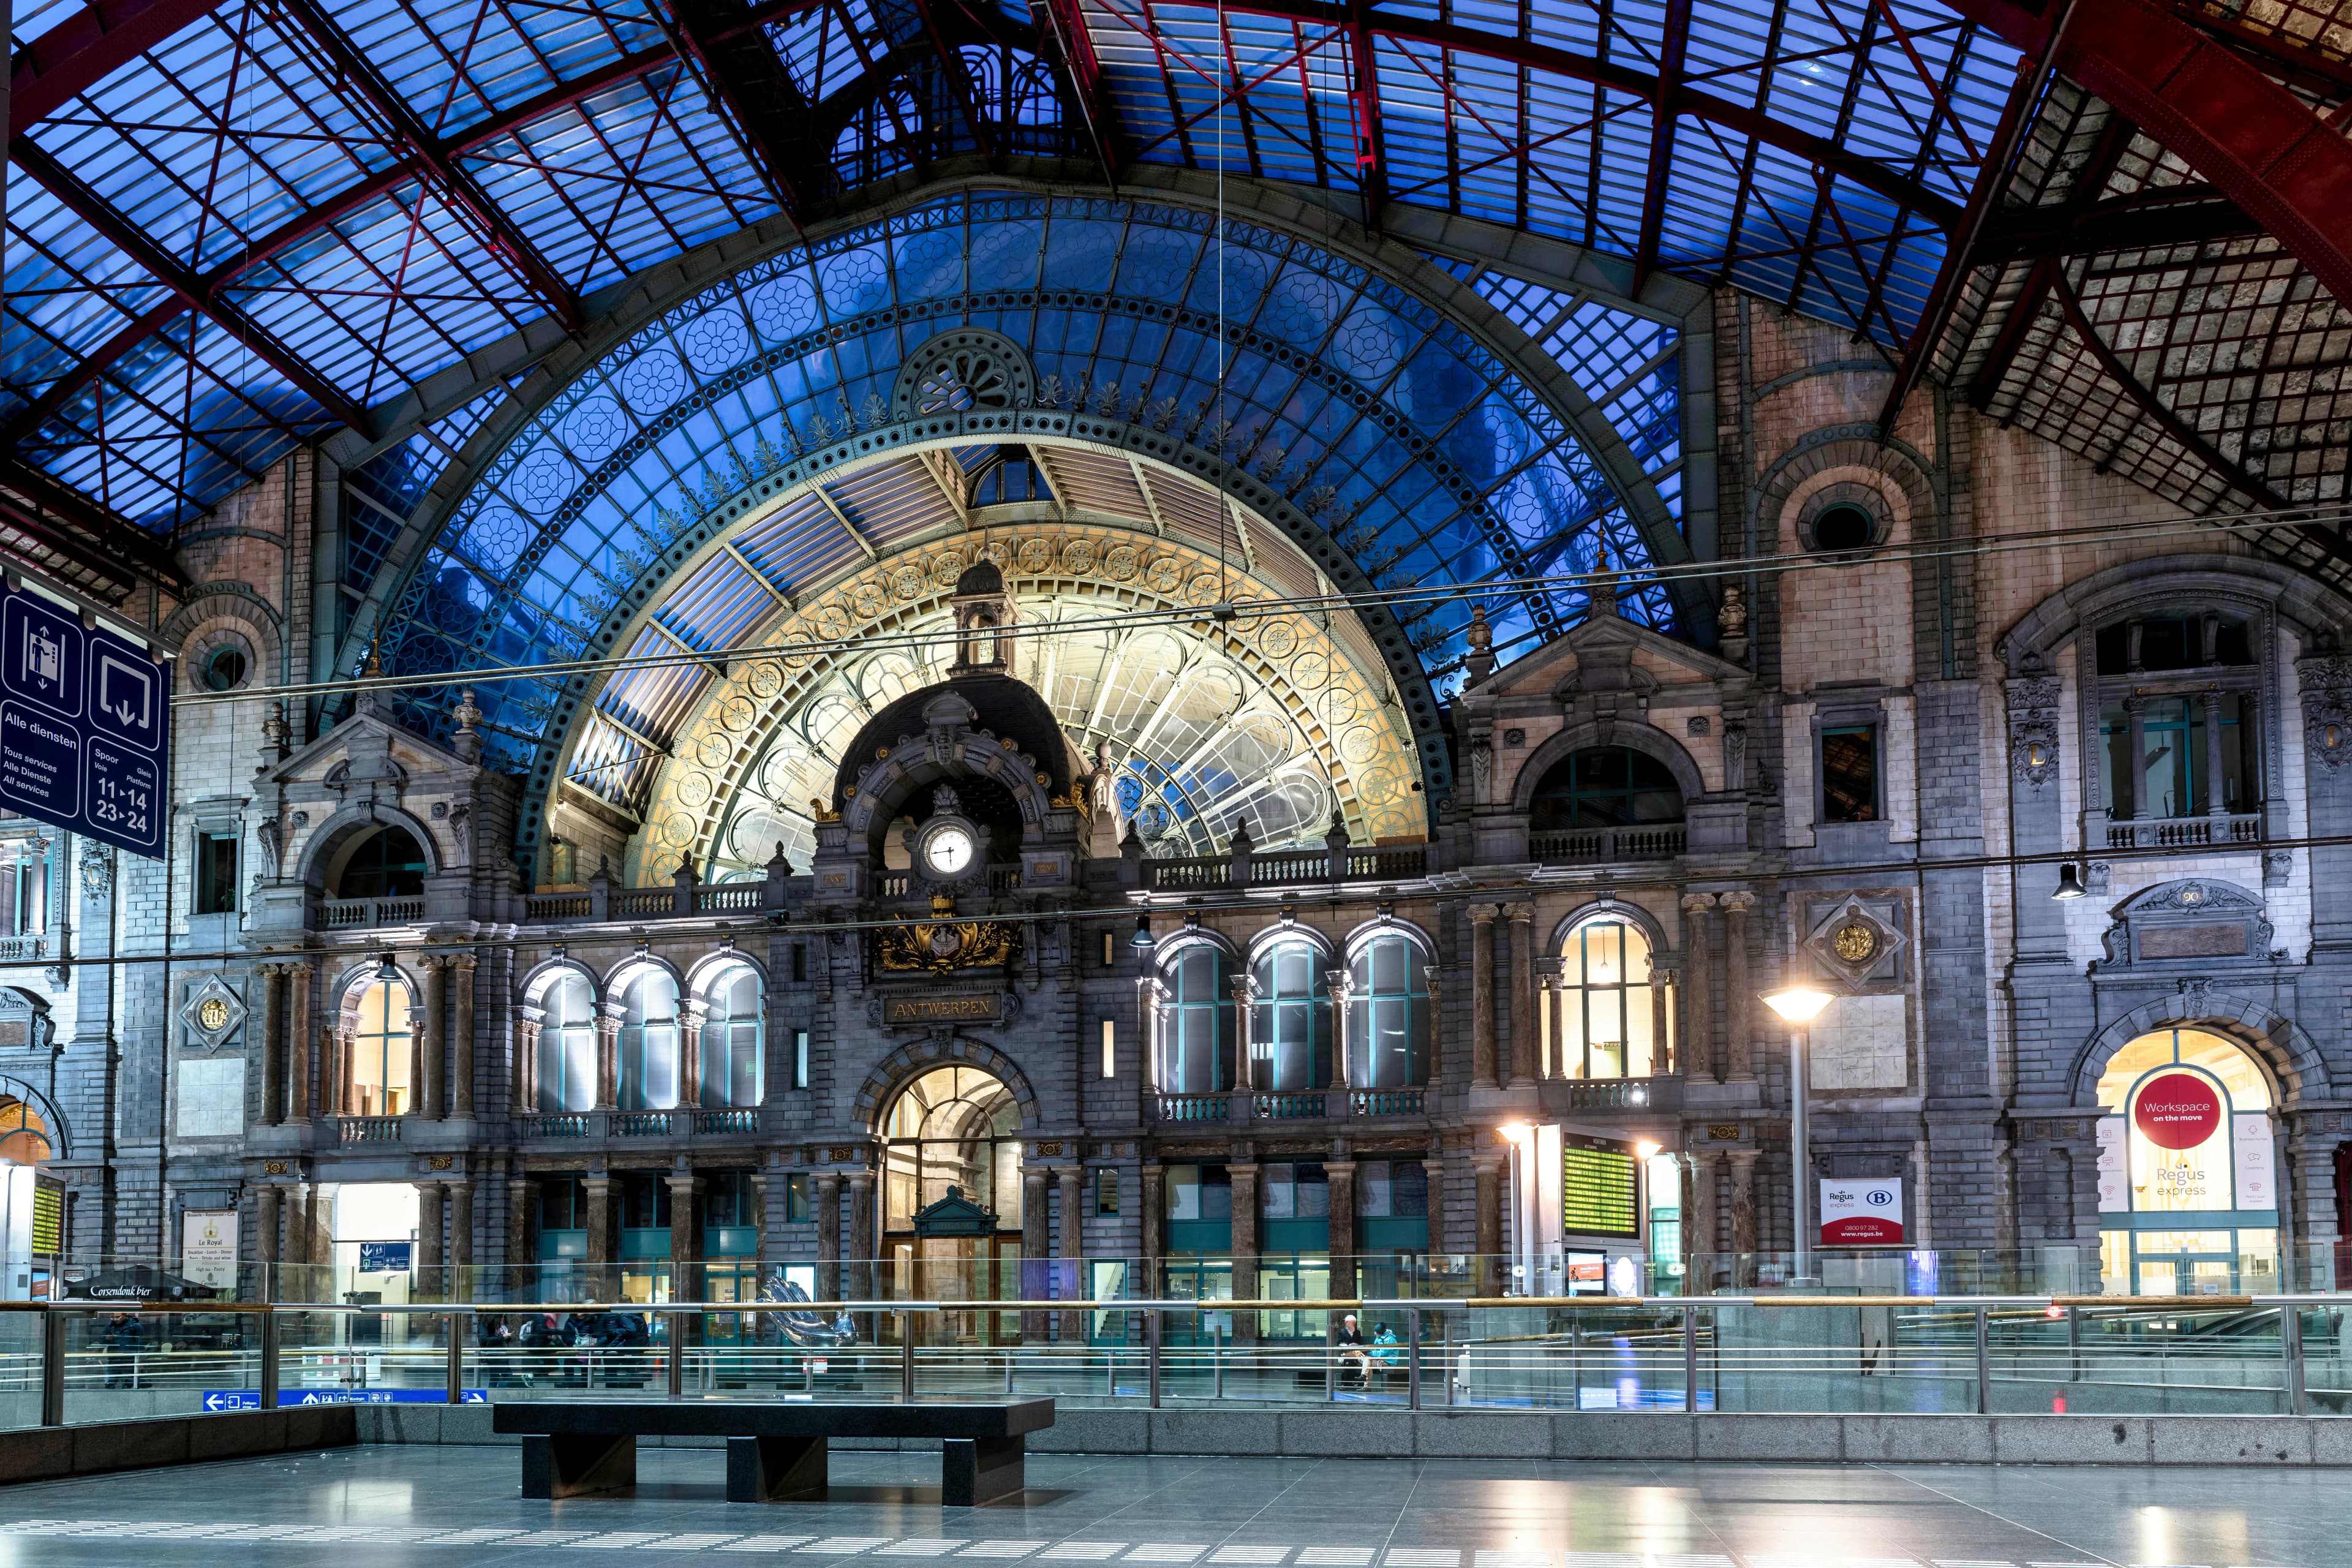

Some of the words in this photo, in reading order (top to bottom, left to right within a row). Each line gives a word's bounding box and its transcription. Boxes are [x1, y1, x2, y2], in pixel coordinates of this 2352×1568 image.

[4, 712, 27, 729] Alle
[29, 723, 77, 750] diensten
[4, 745, 23, 760] Tous
[24, 755, 57, 772] services
[95, 748, 119, 764] Spoor
[137, 767, 151, 778] Gleis
[3, 760, 19, 772] Alle
[21, 766, 51, 785] Dienste
[94, 761, 108, 772] Voie
[126, 774, 151, 790] Platform
[2, 775, 15, 785] All
[15, 780, 50, 797] services
[98, 777, 115, 799] 11
[127, 789, 147, 810] 14
[96, 799, 117, 821] 23
[127, 810, 147, 832] 24
[2181, 892, 2203, 902] 1905
[894, 1000, 990, 1017] ANTWERPEN
[2144, 1102, 2210, 1114] Workspace
[2157, 1167, 2205, 1186] Regus
[1830, 1192, 1854, 1202] Regus
[2157, 1186, 2206, 1198] express
[90, 1284, 136, 1297] Corsendonk
[136, 1284, 153, 1296] bier
